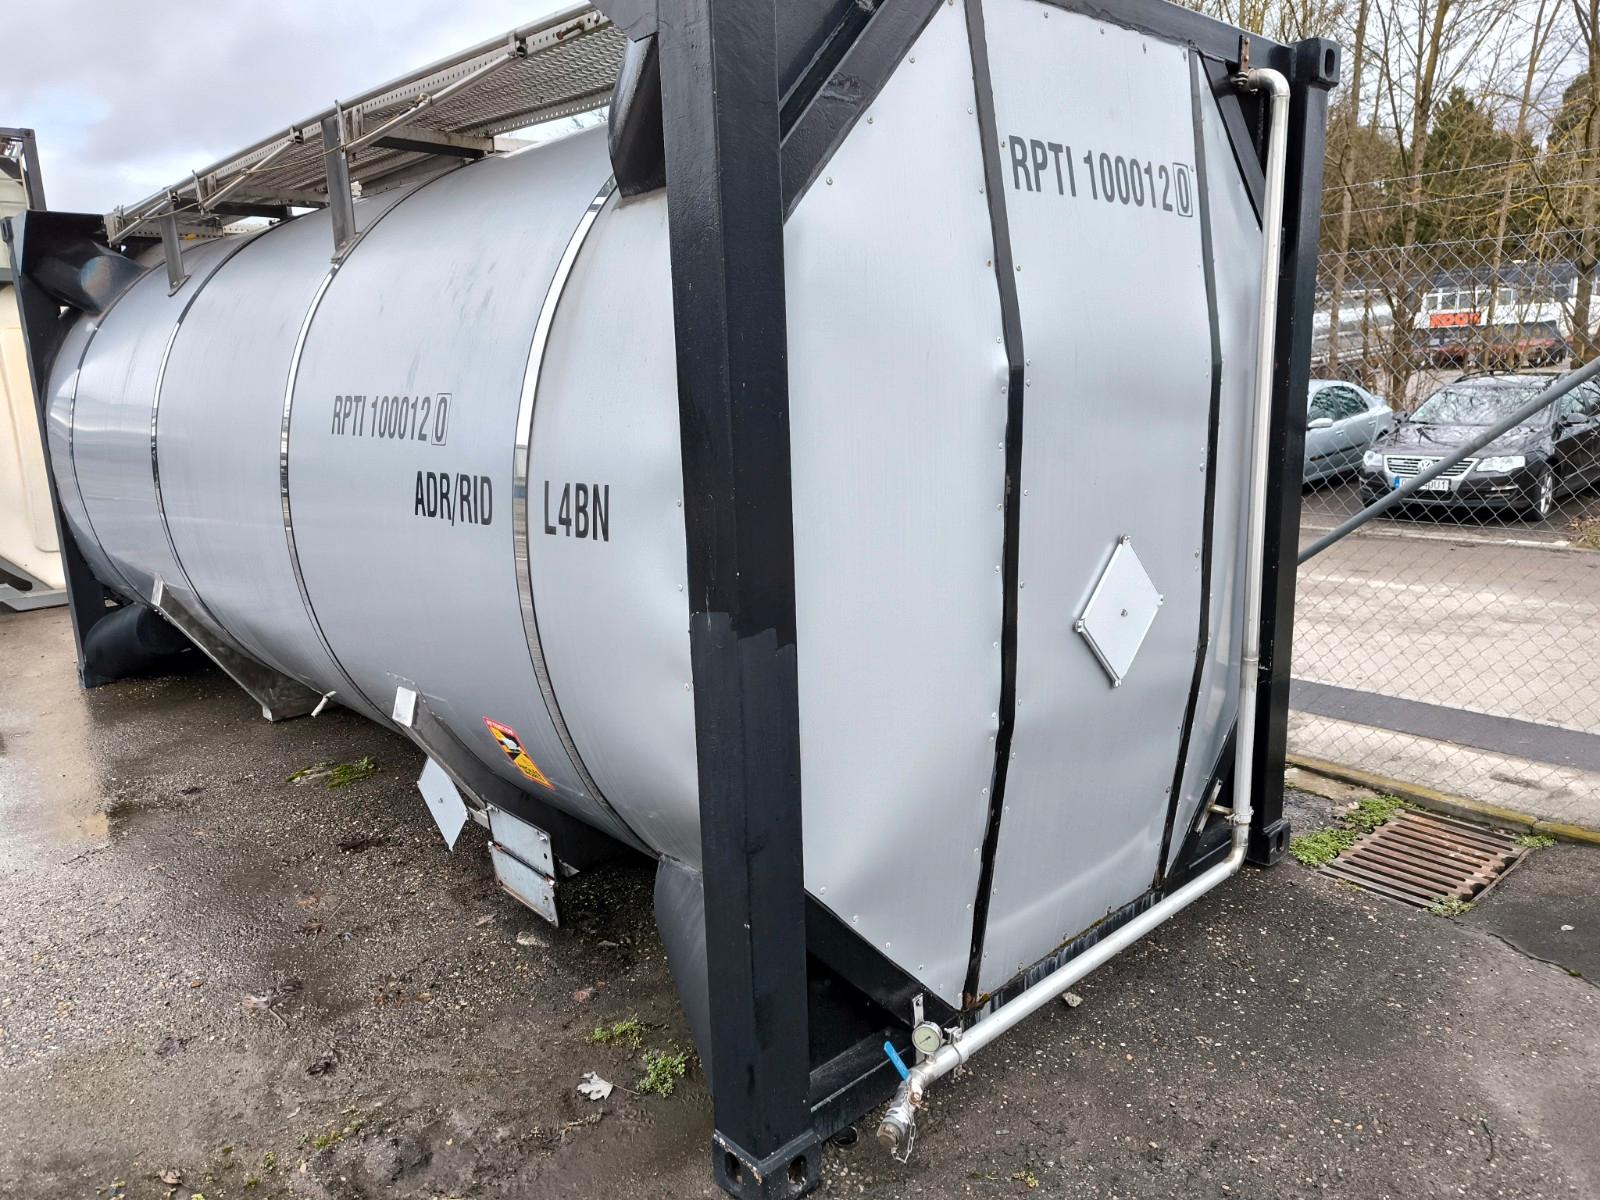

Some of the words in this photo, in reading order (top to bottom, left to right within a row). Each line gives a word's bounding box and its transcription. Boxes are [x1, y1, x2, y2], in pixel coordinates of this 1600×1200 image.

[1009, 135, 1077, 197] RPTI
[332, 396, 366, 436] RPTI
[415, 471, 493, 526] ADR/RID
[544, 480, 610, 542] L4BN
